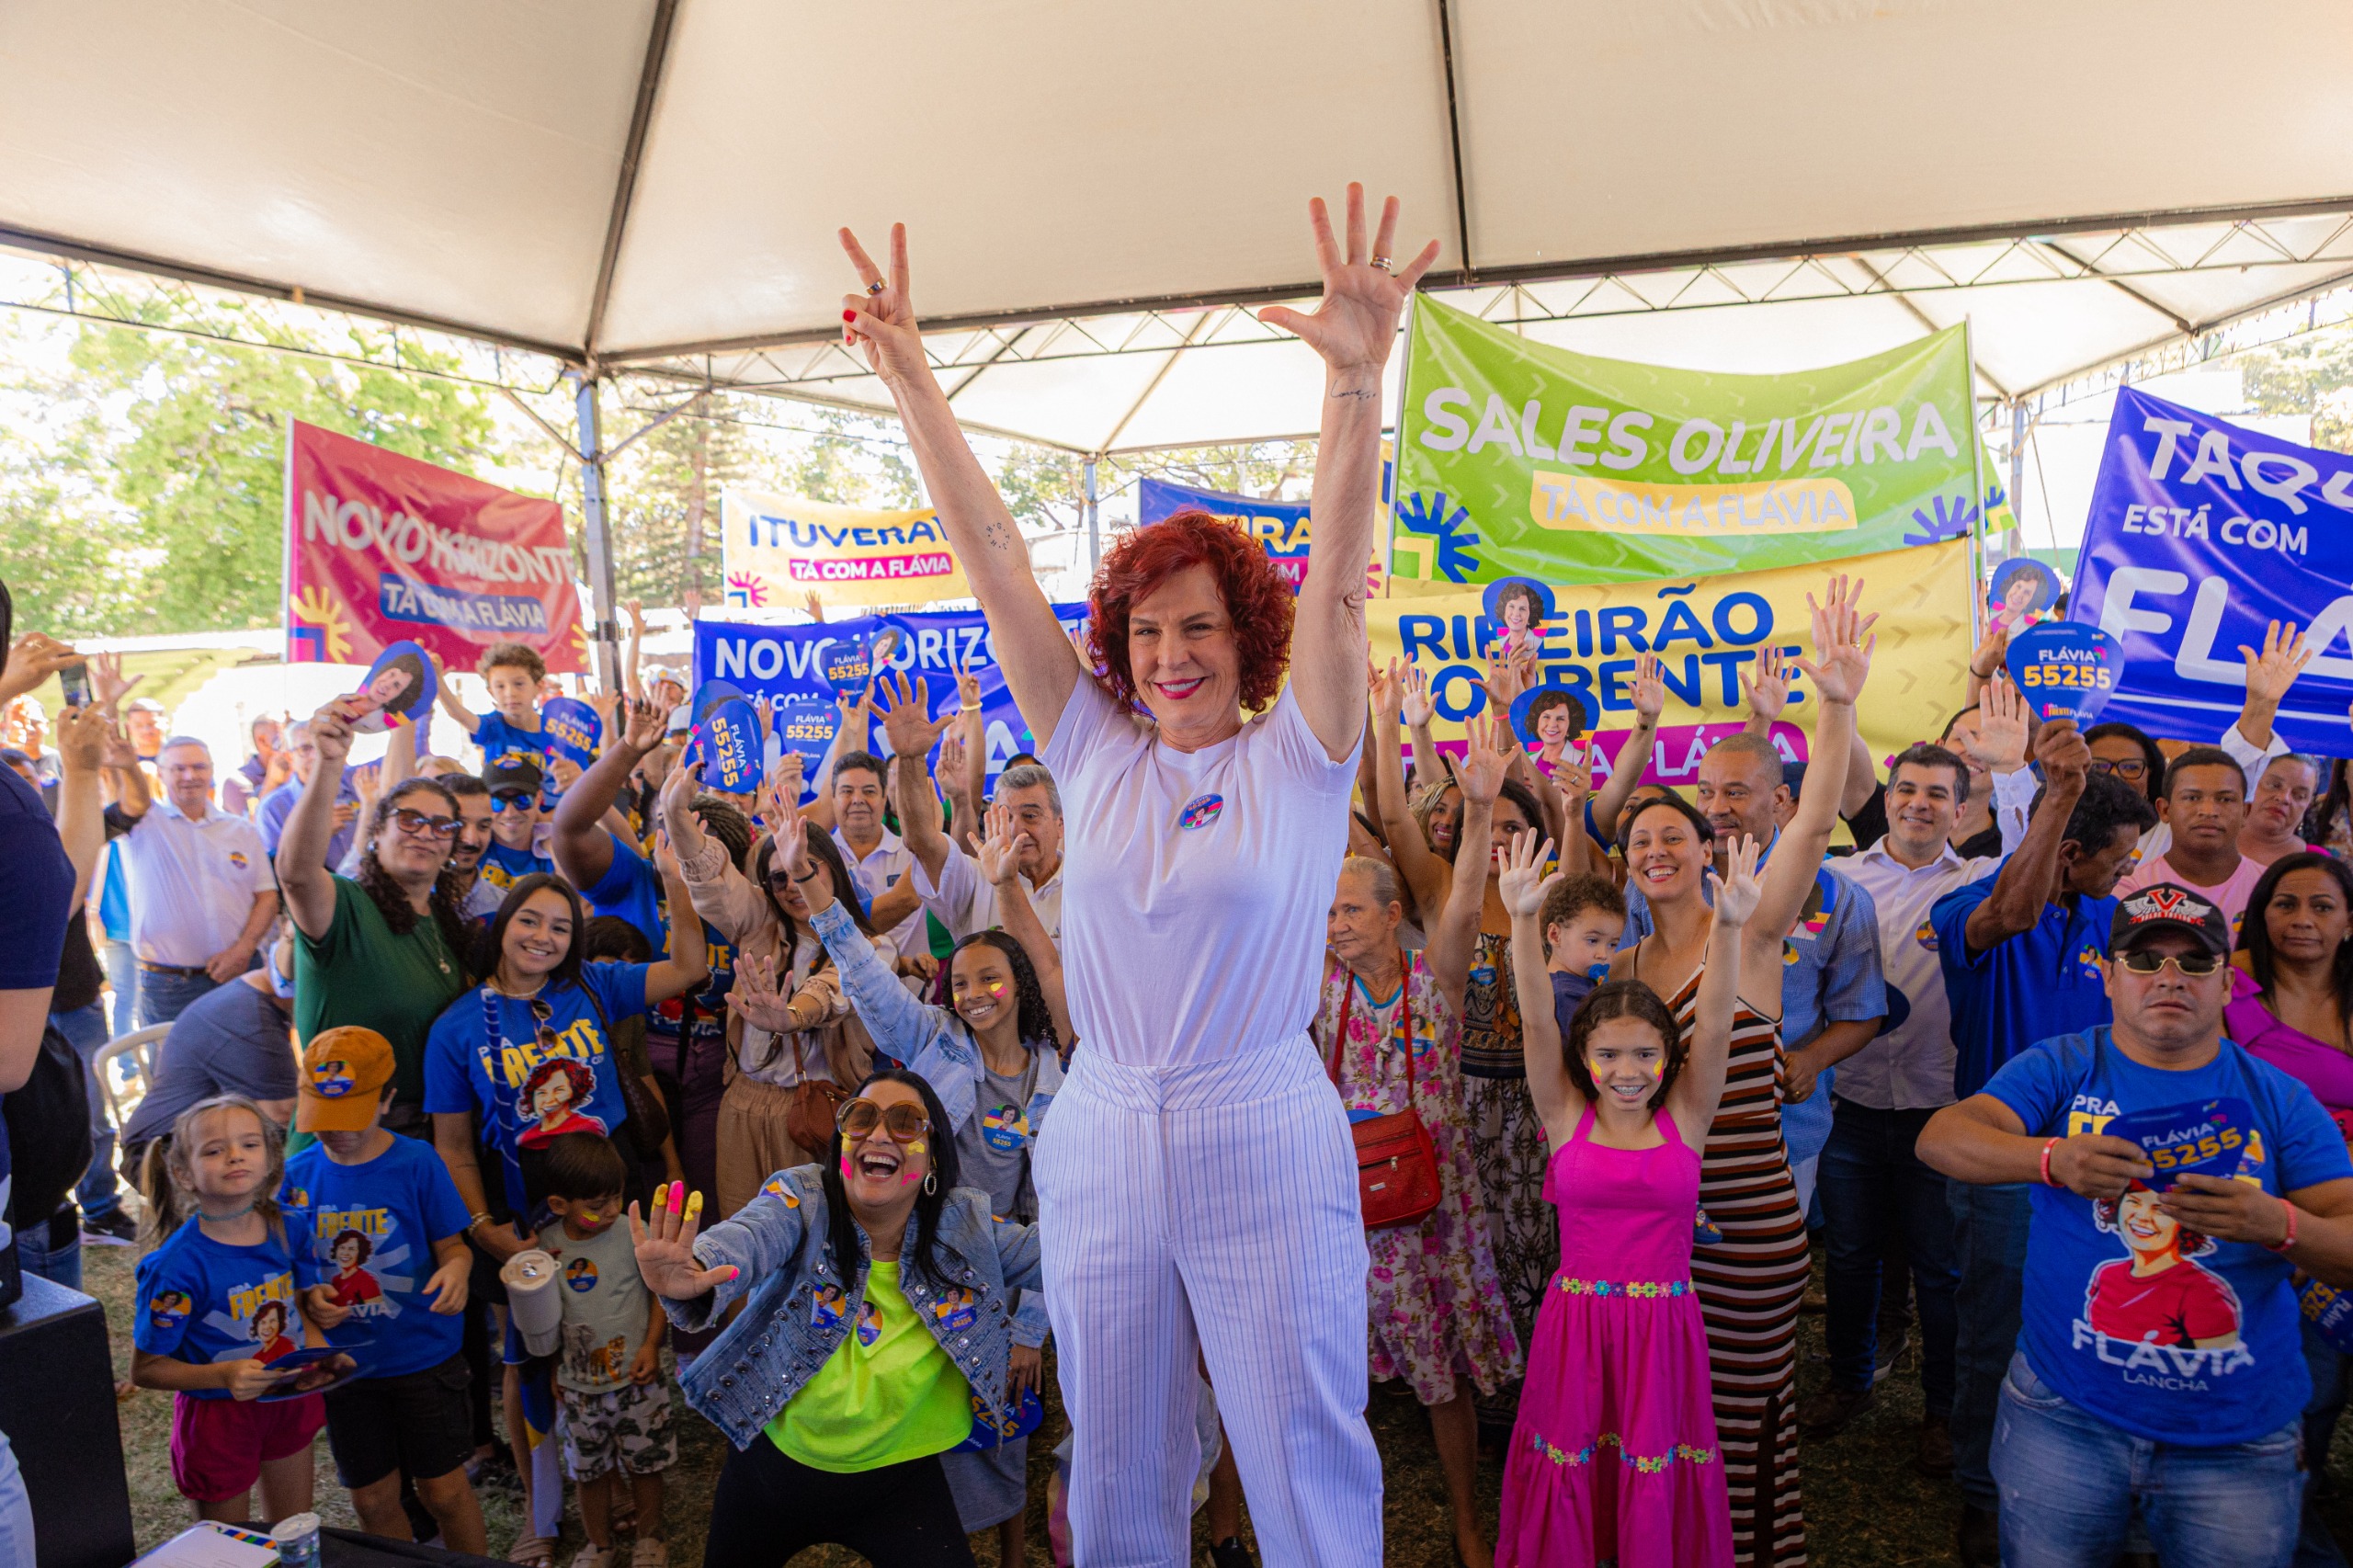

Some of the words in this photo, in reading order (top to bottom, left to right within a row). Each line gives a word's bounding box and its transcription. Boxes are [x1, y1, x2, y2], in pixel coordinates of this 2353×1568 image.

[1420, 387, 1654, 471] SALES
[1669, 403, 1958, 474] OLIVEIRA
[1540, 477, 1590, 522] TÁ
[1596, 491, 1673, 528] COM
[1682, 496, 1710, 528] A
[1719, 483, 1849, 527] FLÁVIA
[304, 489, 428, 563] NOVO
[2122, 503, 2211, 540] ESTÁ
[2221, 517, 2308, 555] COM
[791, 558, 819, 580] TÁ
[822, 562, 869, 579] COM
[870, 561, 886, 578] A
[889, 553, 951, 577] FLÁVIA
[383, 581, 418, 616] TÁ
[477, 597, 547, 629] FLÁVIA
[835, 653, 861, 665] FLÁVIA
[2039, 646, 2096, 662] FLÁVIA
[828, 663, 870, 680] 55255
[2024, 665, 2111, 689] 55255
[795, 713, 825, 723] FLÁVIA
[544, 717, 593, 752] 55255
[731, 723, 746, 768] FLÁVIA
[786, 724, 834, 740] 55255
[711, 717, 739, 787] 55255
[2146, 888, 2188, 911] V
[477, 1036, 515, 1059] PA
[2072, 1094, 2121, 1117] PRA
[2142, 1122, 2215, 1148] FLÁVIA
[316, 1208, 389, 1239] FRENTE
[230, 1270, 294, 1322] FRENTE
[2072, 1318, 2256, 1377] FLÁVIA
[2123, 1369, 2210, 1392] LANCHA
